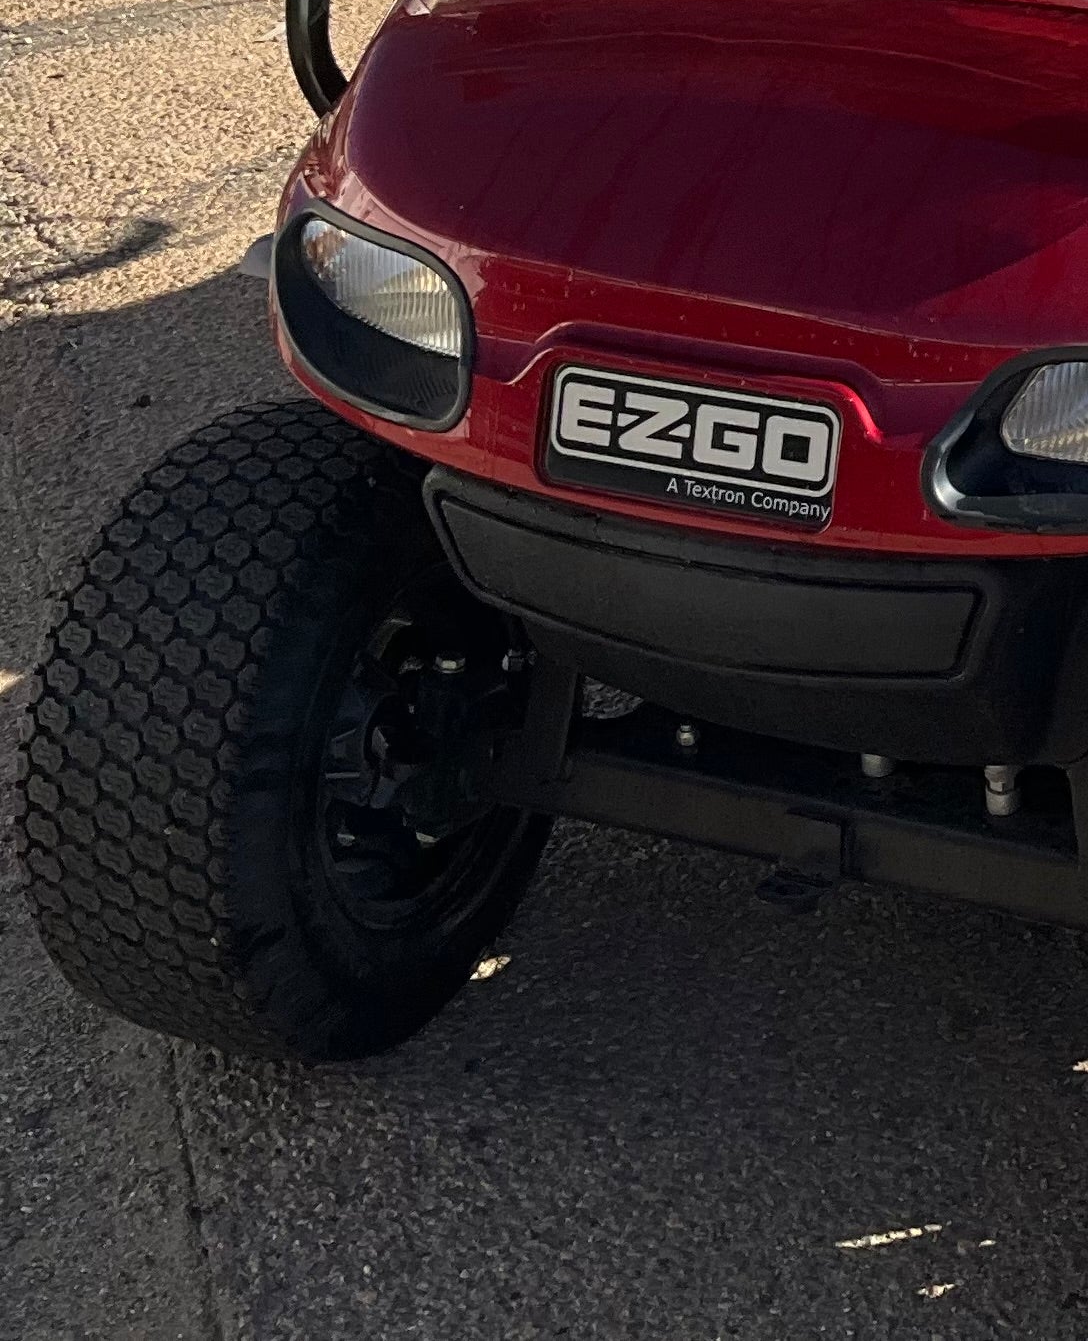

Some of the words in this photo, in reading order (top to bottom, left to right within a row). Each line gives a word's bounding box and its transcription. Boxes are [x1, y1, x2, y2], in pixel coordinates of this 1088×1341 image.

[559, 381, 830, 482] EZGO
[666, 477, 679, 494] A
[684, 479, 745, 505] Textron
[751, 491, 831, 522] Company
